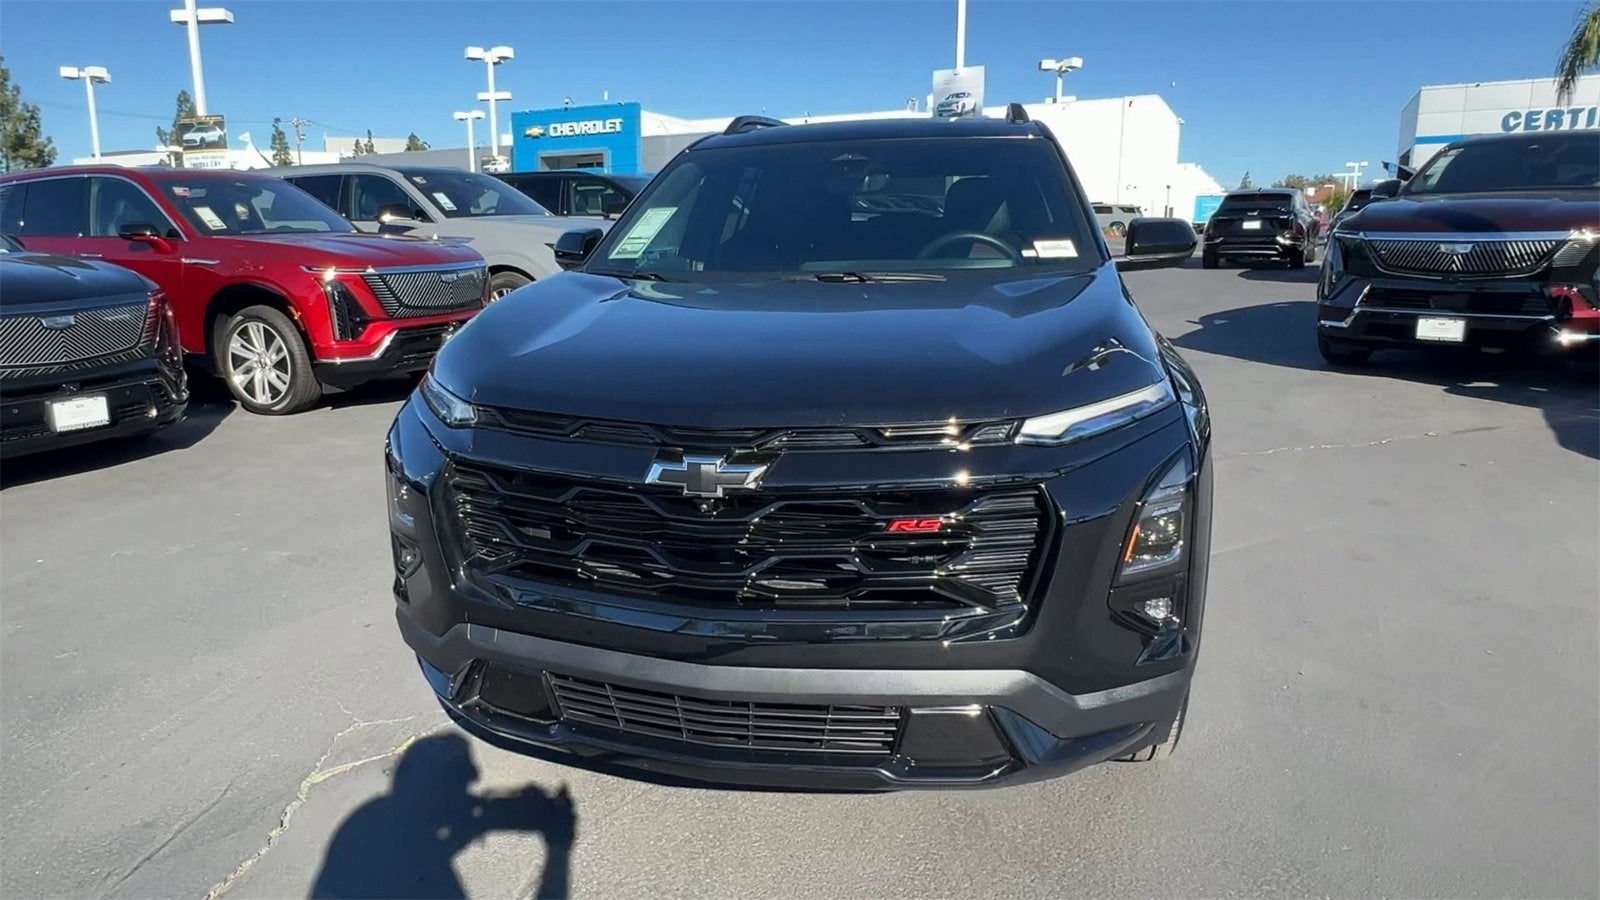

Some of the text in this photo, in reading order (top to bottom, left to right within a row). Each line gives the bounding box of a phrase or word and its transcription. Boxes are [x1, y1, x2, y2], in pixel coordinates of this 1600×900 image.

[549, 118, 623, 138] CHEVROLET
[1501, 106, 1600, 132] CERTI
[887, 518, 943, 533] RS
